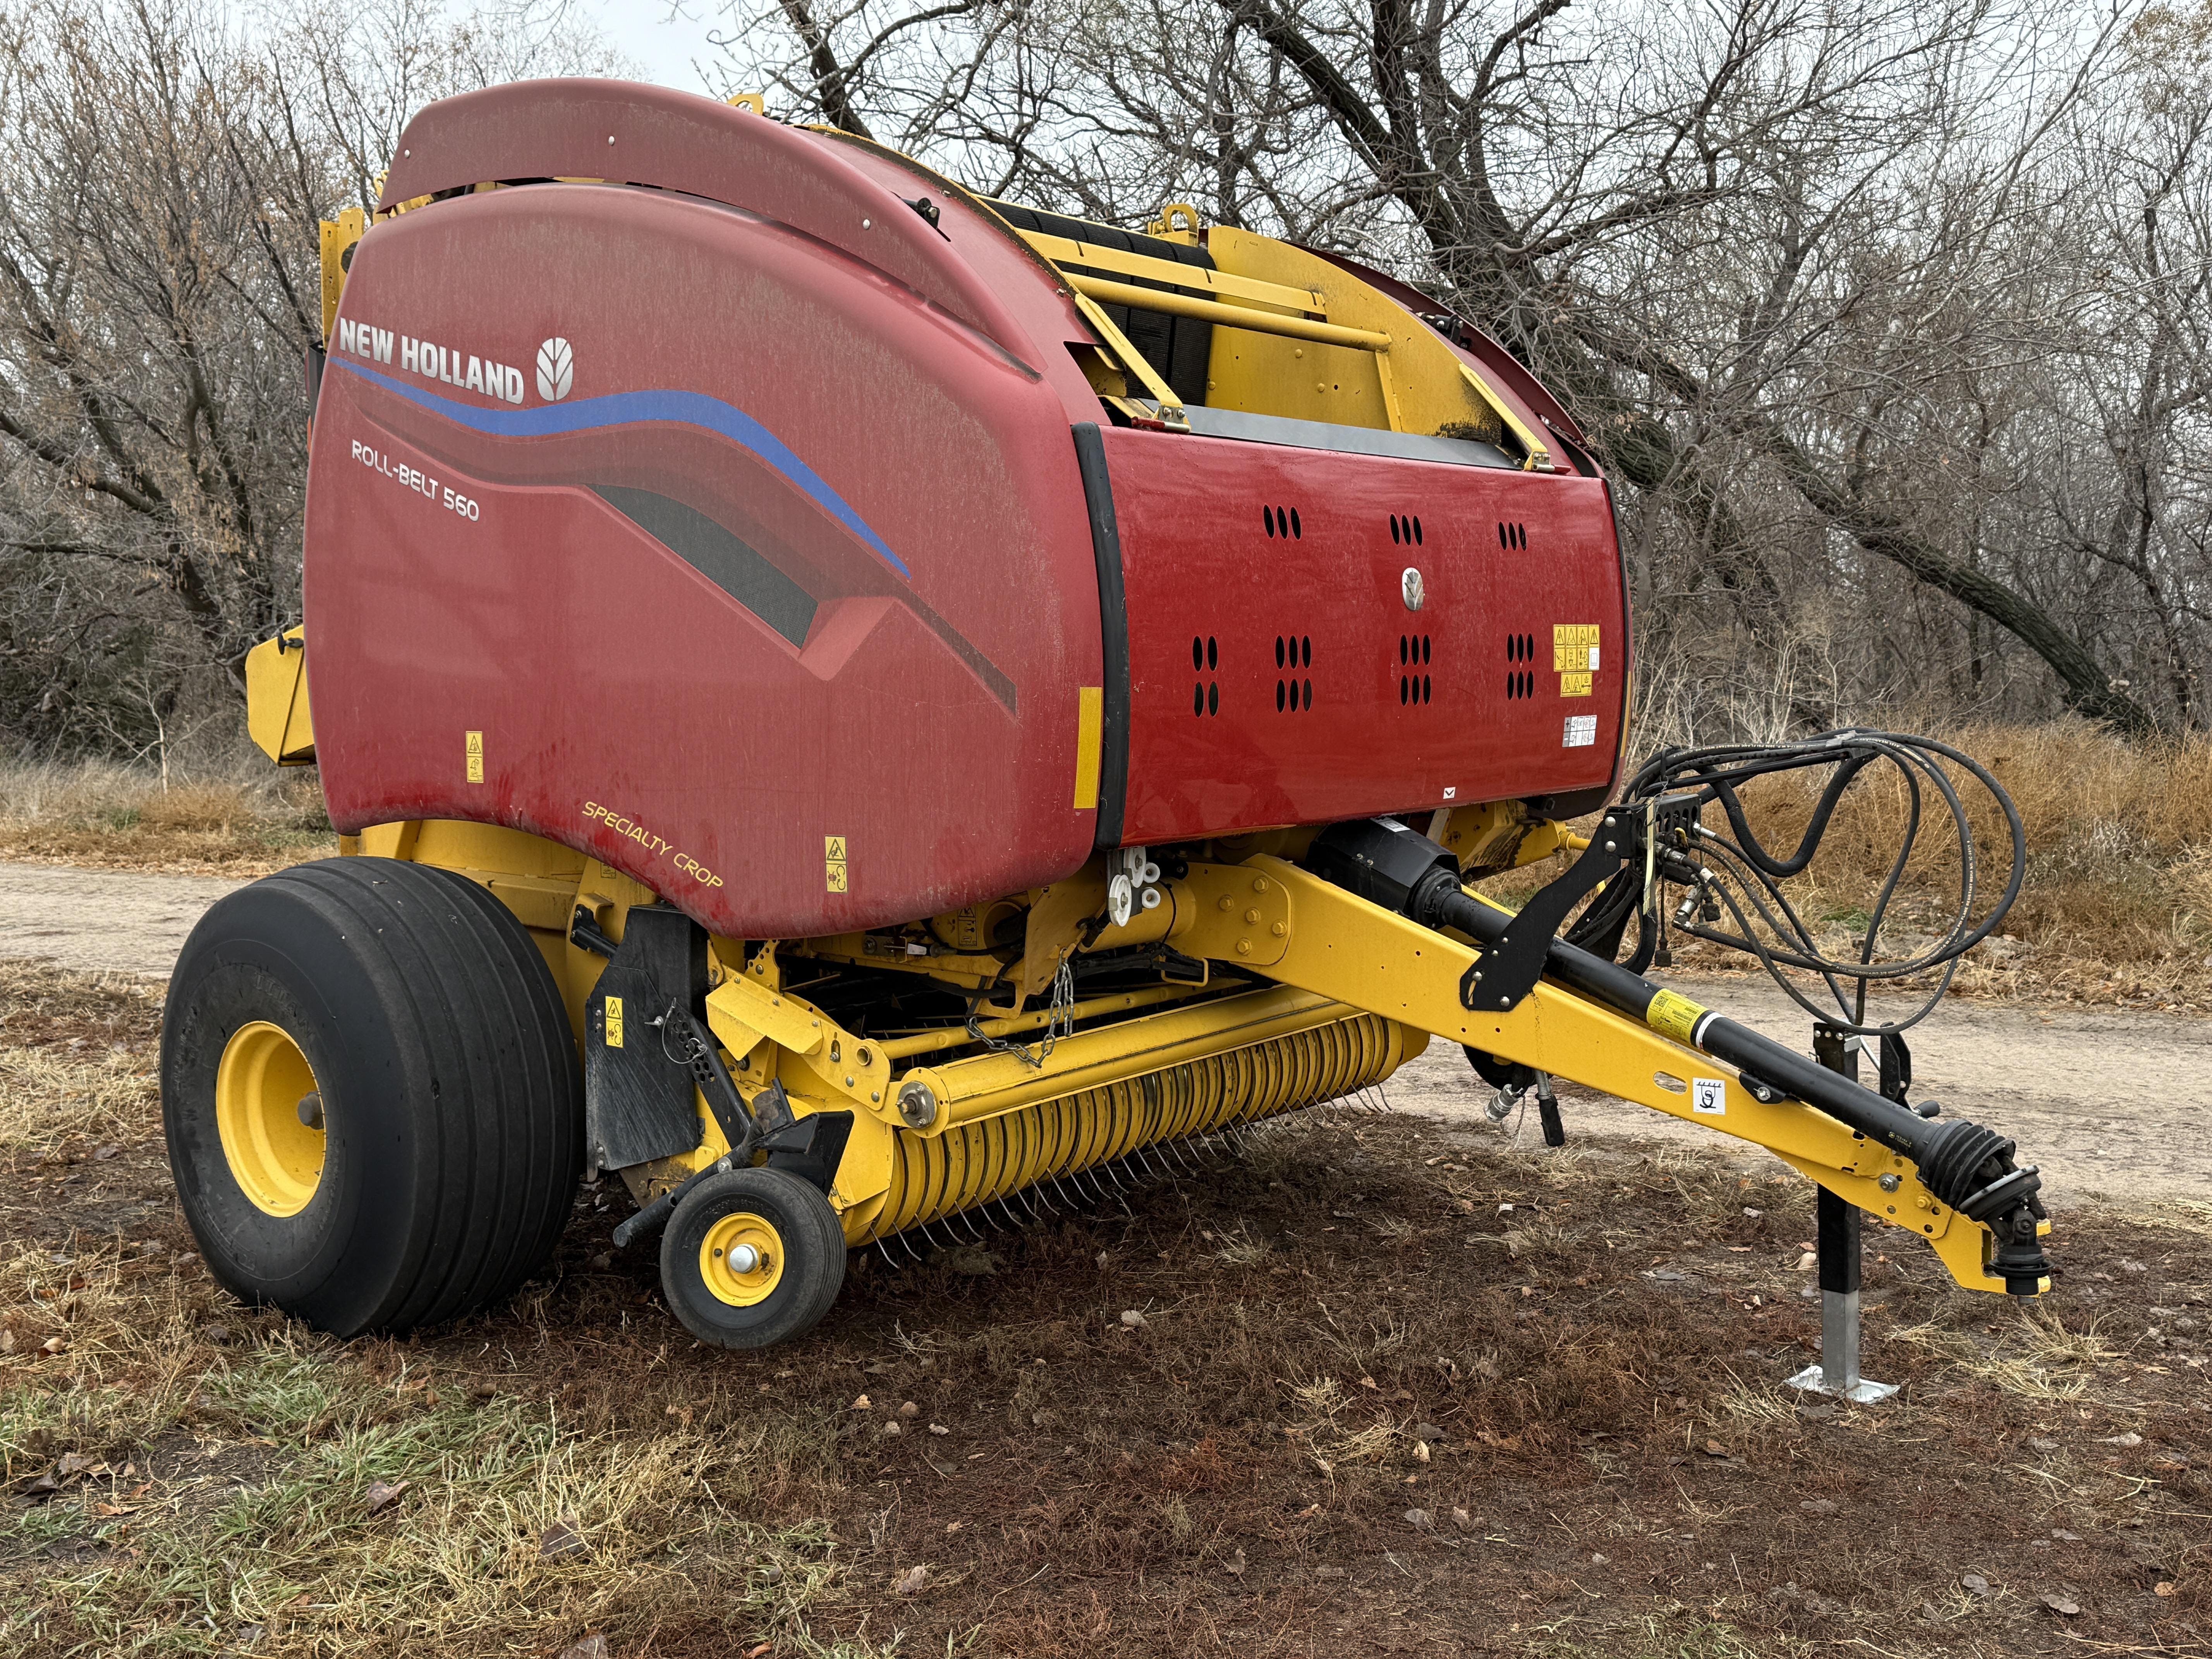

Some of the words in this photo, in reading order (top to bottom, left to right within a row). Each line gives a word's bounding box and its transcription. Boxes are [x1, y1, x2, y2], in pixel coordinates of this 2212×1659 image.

[340, 317, 394, 365] NEW
[402, 335, 524, 404] HOLLAND
[352, 439, 438, 500] ROLL-BELT
[443, 486, 479, 521] 560
[582, 801, 673, 855] SPECIALTY
[673, 853, 723, 887] CROP
